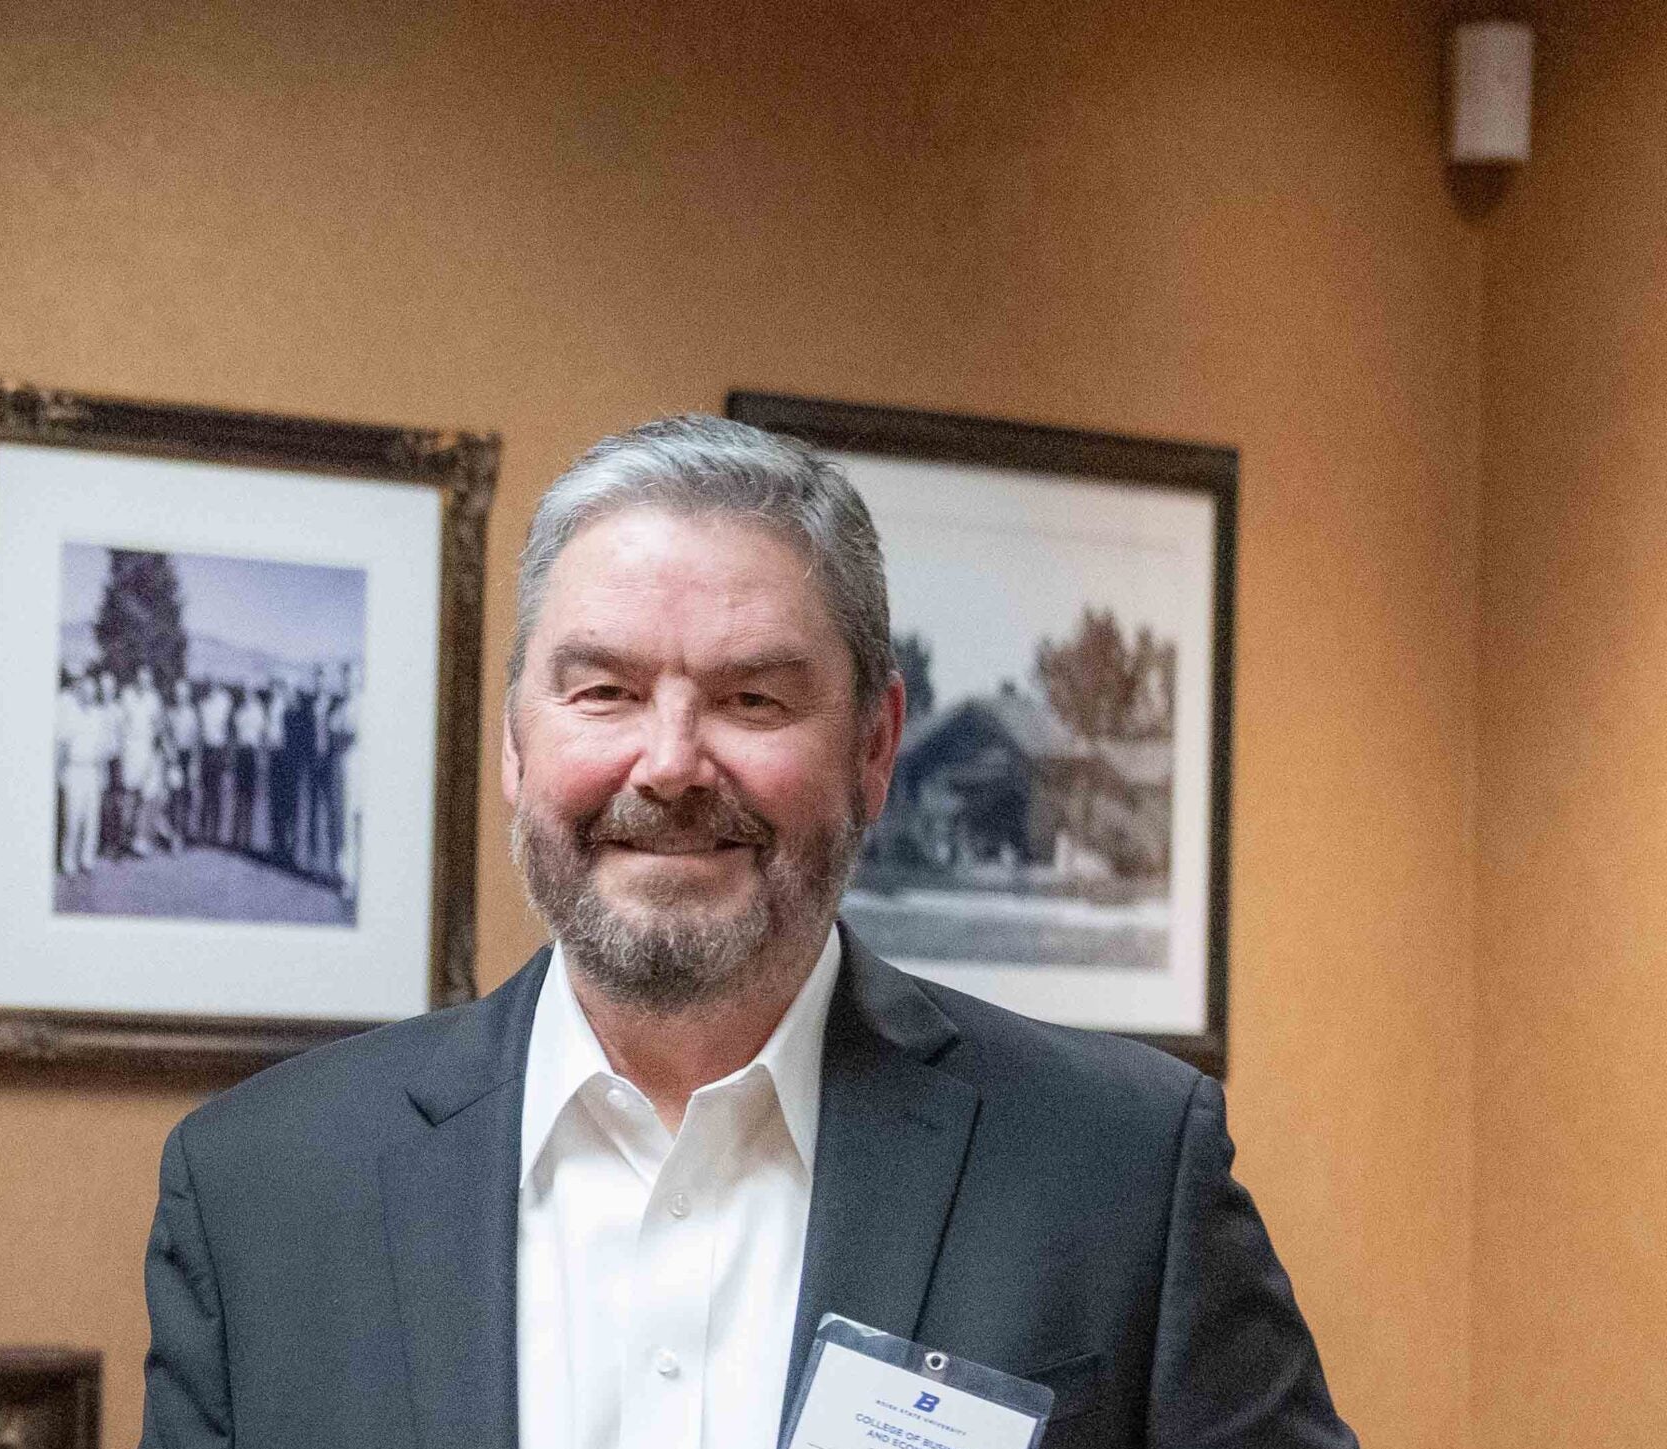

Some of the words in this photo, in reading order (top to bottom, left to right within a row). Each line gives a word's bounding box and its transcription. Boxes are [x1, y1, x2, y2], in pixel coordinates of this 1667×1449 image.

[913, 1390, 940, 1413] B
[855, 1413, 904, 1436] COLLEGE
[906, 1432, 921, 1441] OF
[867, 1430, 889, 1443] AND
